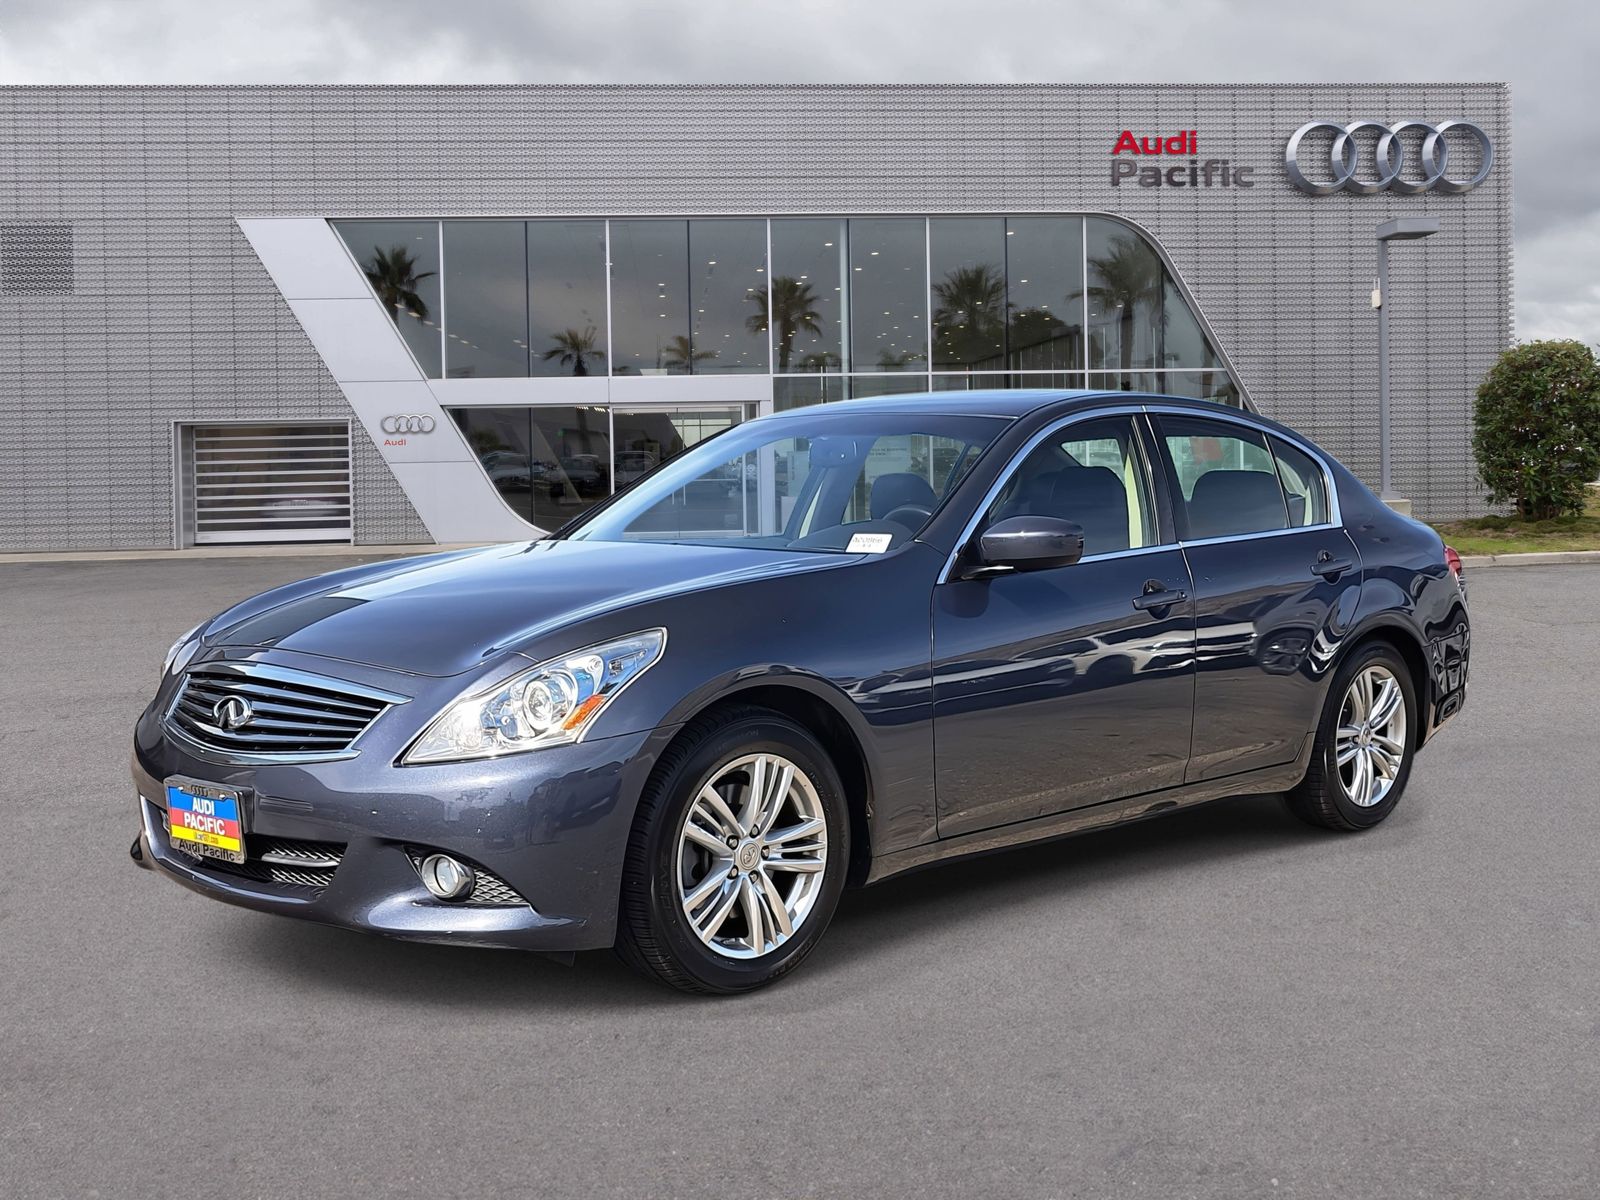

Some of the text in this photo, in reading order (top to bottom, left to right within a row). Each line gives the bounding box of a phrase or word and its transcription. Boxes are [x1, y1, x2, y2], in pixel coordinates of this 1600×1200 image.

[1112, 130, 1197, 155] Audi
[1111, 159, 1255, 187] Pacific
[384, 438, 407, 446] Audi
[192, 797, 215, 816] AUDI
[183, 812, 226, 835] PACIFIC
[179, 840, 236, 861] Audi Pacific
